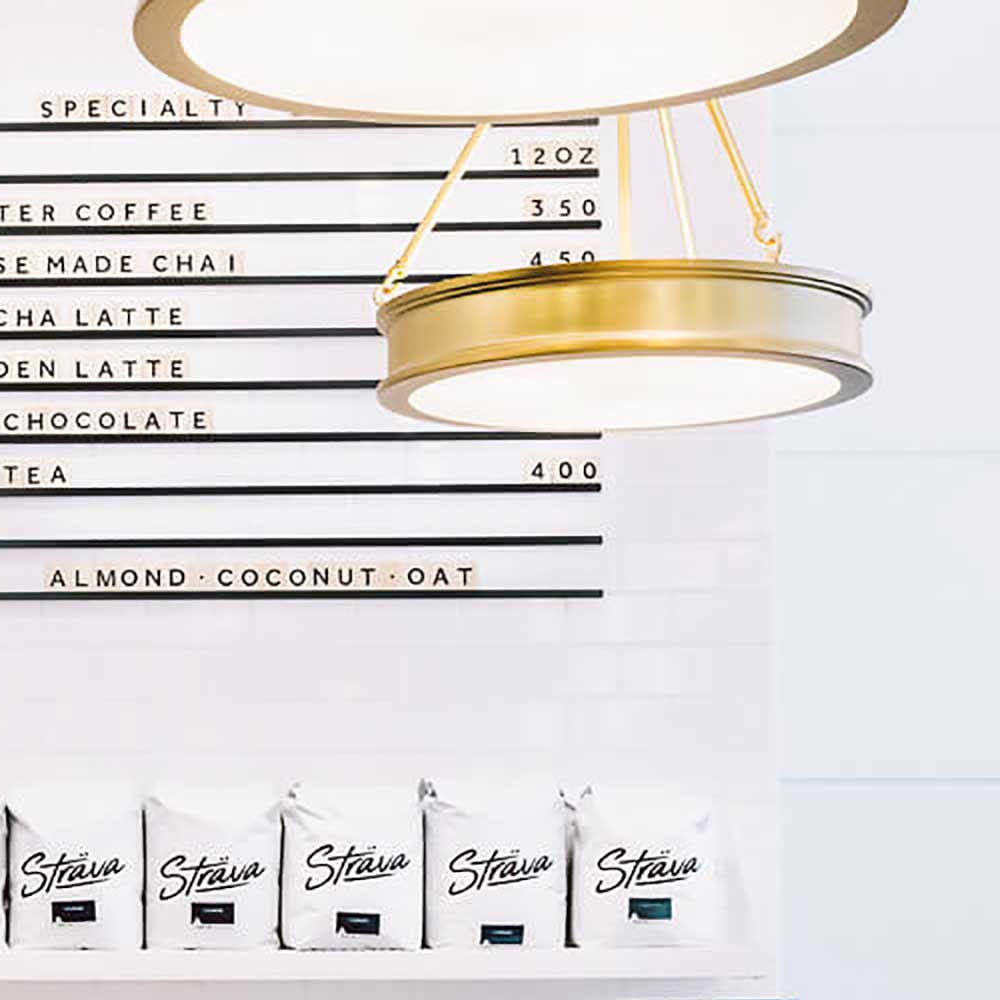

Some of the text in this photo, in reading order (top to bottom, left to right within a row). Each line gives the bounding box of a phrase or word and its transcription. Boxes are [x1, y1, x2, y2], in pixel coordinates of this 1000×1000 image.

[40, 99, 244, 119] SPECIALTY
[511, 147, 593, 165] 12OZ
[75, 203, 206, 222] COFFEE
[531, 198, 596, 217] 350
[47, 255, 132, 273] MADE
[152, 254, 235, 273] CHAI
[76, 307, 182, 327] LATTE
[75, 359, 183, 379] LATTE
[3, 411, 206, 431] CHOCOLATE
[3, 465, 67, 485] TEA
[531, 461, 597, 480] 400
[49, 567, 473, 587] ALMOND COCONUT OAT
